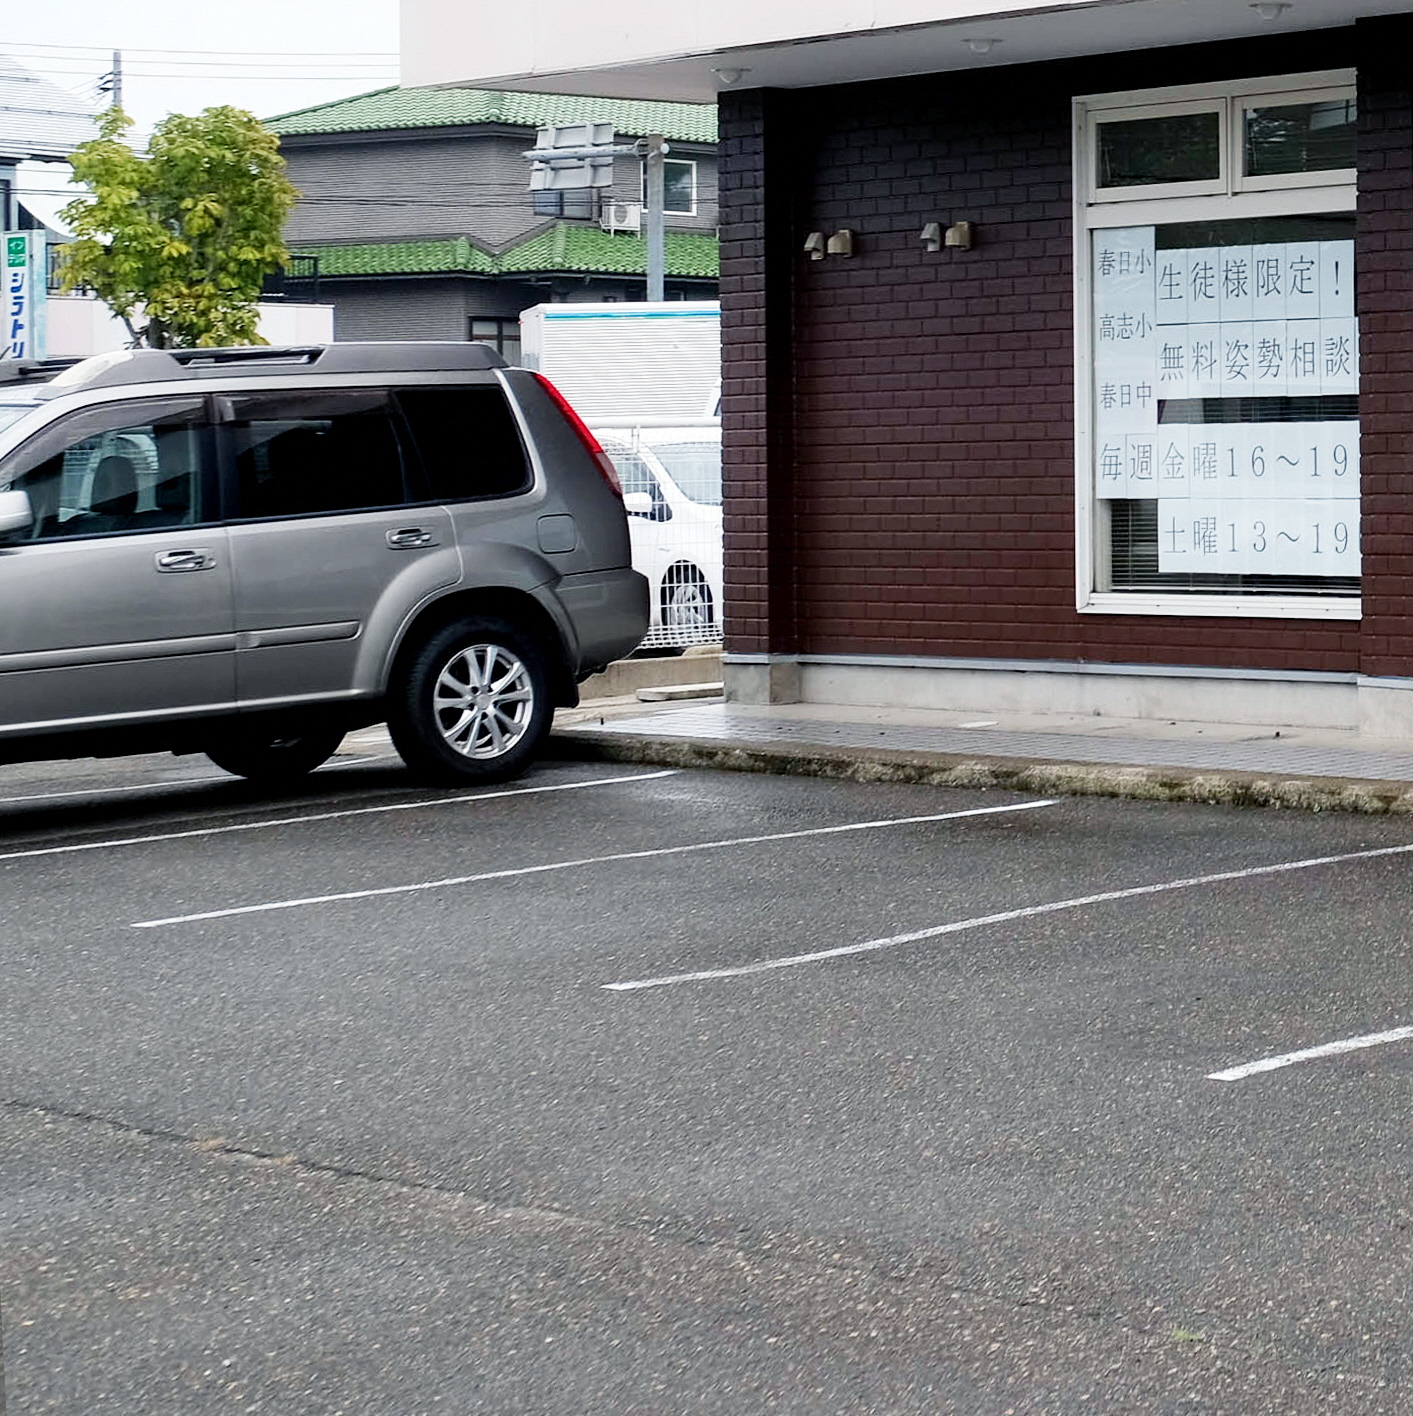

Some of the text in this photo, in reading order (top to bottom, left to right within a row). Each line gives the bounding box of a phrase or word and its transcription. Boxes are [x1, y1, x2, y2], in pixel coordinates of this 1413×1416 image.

[1098, 248, 1153, 277] 春日小
[1099, 312, 1153, 341] 高志小
[1160, 336, 1352, 382] 無料姿勢相談
[1100, 381, 1153, 410] 春日中
